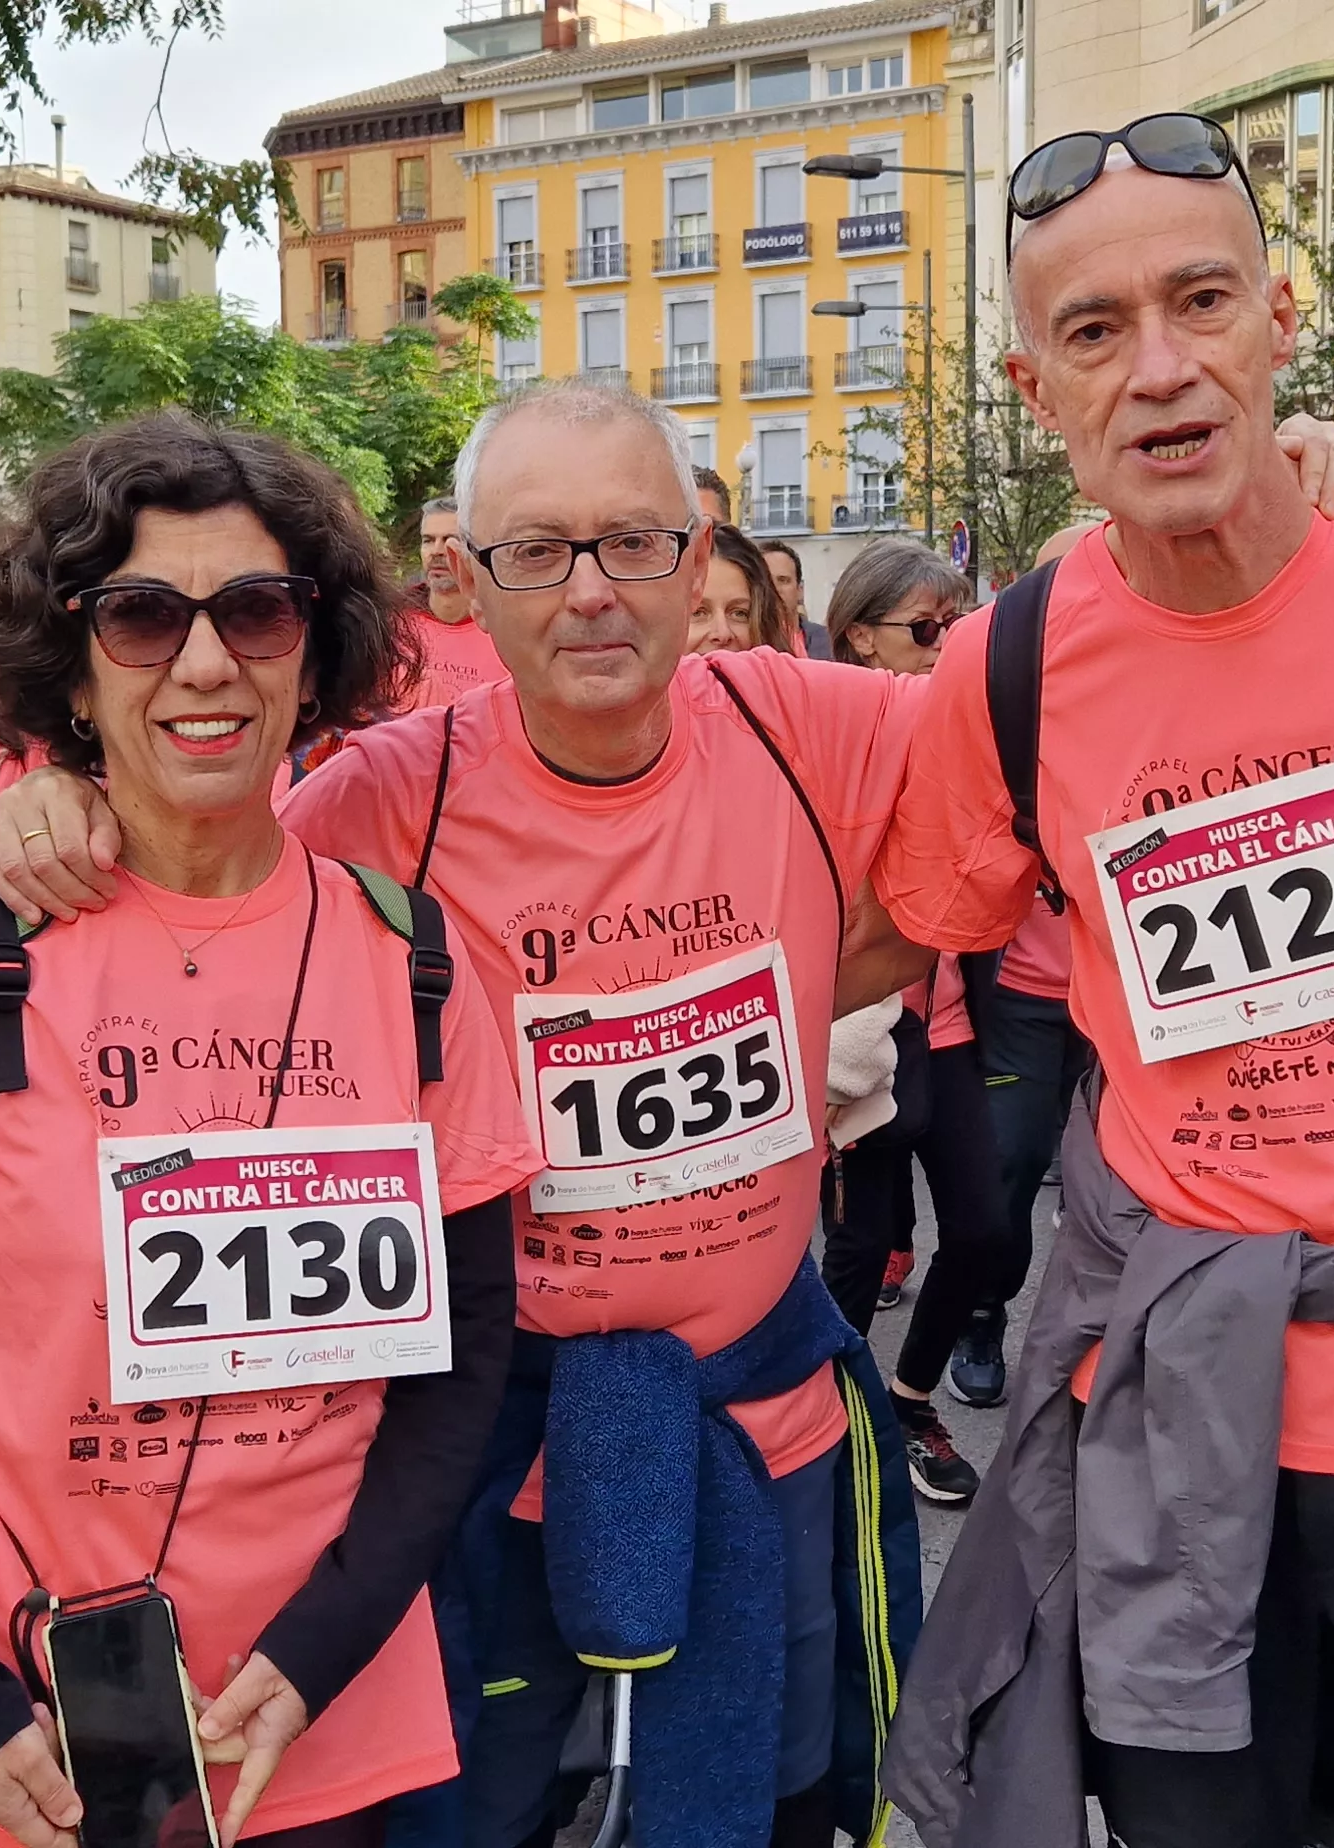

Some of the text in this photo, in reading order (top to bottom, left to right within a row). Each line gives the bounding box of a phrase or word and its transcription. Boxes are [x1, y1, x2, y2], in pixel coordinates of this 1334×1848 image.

[745, 233, 804, 250] PODÓLOGO
[840, 222, 901, 240] 611 59 16 16
[1122, 757, 1190, 808] CONTRA EL
[1208, 811, 1287, 847] HUESCA
[1122, 835, 1163, 867] EDICIÓN
[1132, 849, 1236, 893] CONTRA
[1241, 839, 1272, 864] EL
[501, 901, 579, 940] CONTRA EL
[522, 893, 736, 987] 9ª CÁNCER
[672, 921, 766, 957] HUESCA
[80, 1014, 136, 1052] CONTRA
[141, 1017, 160, 1036] EL
[542, 1015, 584, 1035] EDICIÓN
[548, 996, 768, 1064] CONTRA EL CÁNCER
[633, 1002, 700, 1035] HUESCA
[97, 1028, 335, 1109] 9ª CÁNCER
[1227, 1055, 1320, 1090] QUIÉRETE
[258, 1075, 361, 1100] HUESCA
[551, 1030, 781, 1158] 1635
[133, 1155, 184, 1182] EDICIÓN
[238, 1158, 318, 1180] HUESCA
[696, 1152, 741, 1175] castellar
[141, 1174, 407, 1214] CONTRA EL CÁNCER
[138, 1216, 418, 1331] 2130
[145, 1365, 167, 1376] hoya
[302, 1345, 356, 1364] castellar
[234, 1432, 268, 1445] eboca
